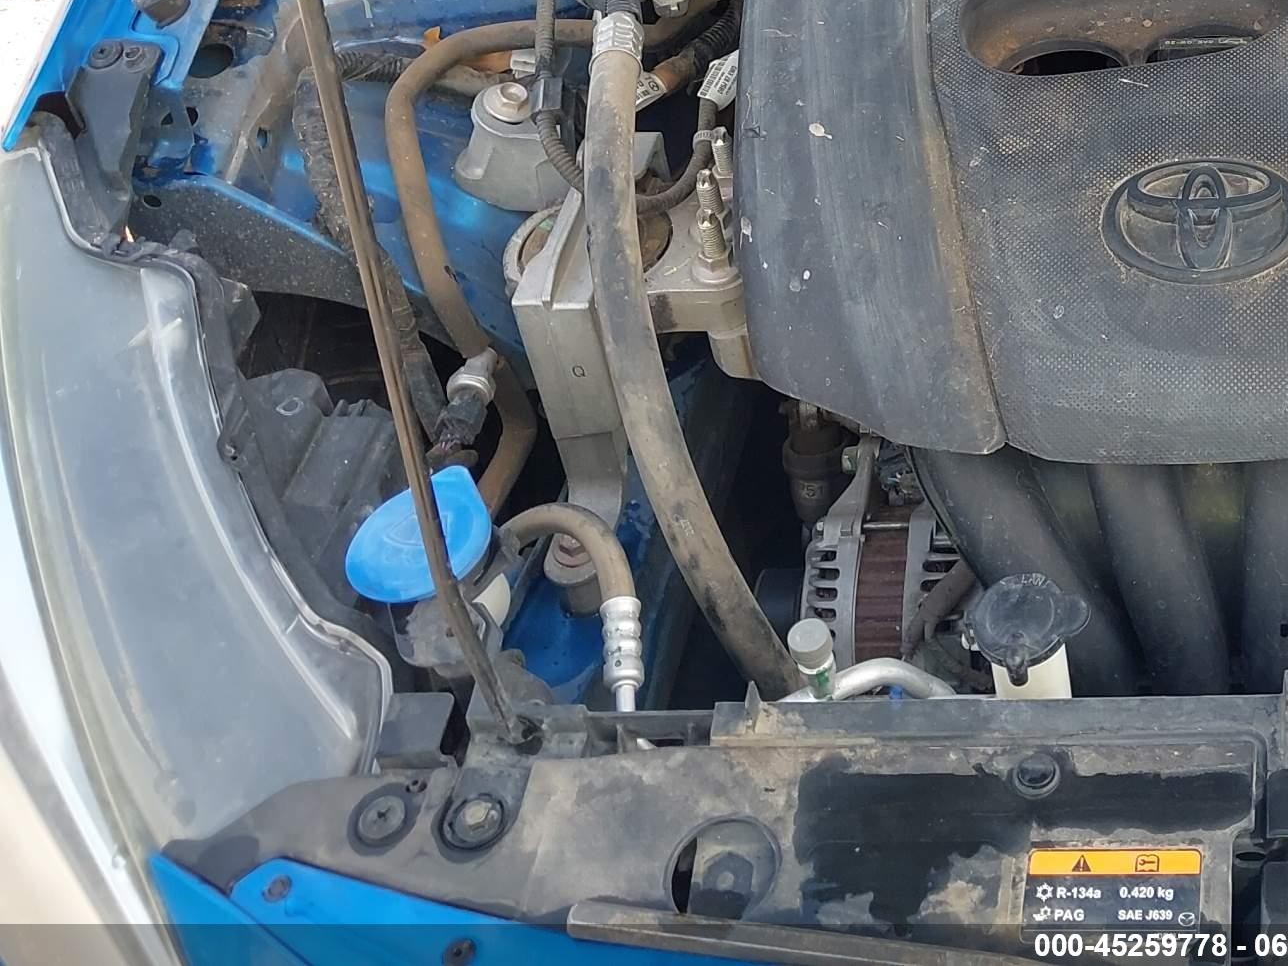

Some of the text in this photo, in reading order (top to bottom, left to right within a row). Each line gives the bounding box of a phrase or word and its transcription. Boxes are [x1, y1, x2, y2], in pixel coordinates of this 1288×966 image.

[1056, 886, 1174, 901] R-134a 0.420 kg
[1054, 909, 1173, 922] PAG SAE J639
